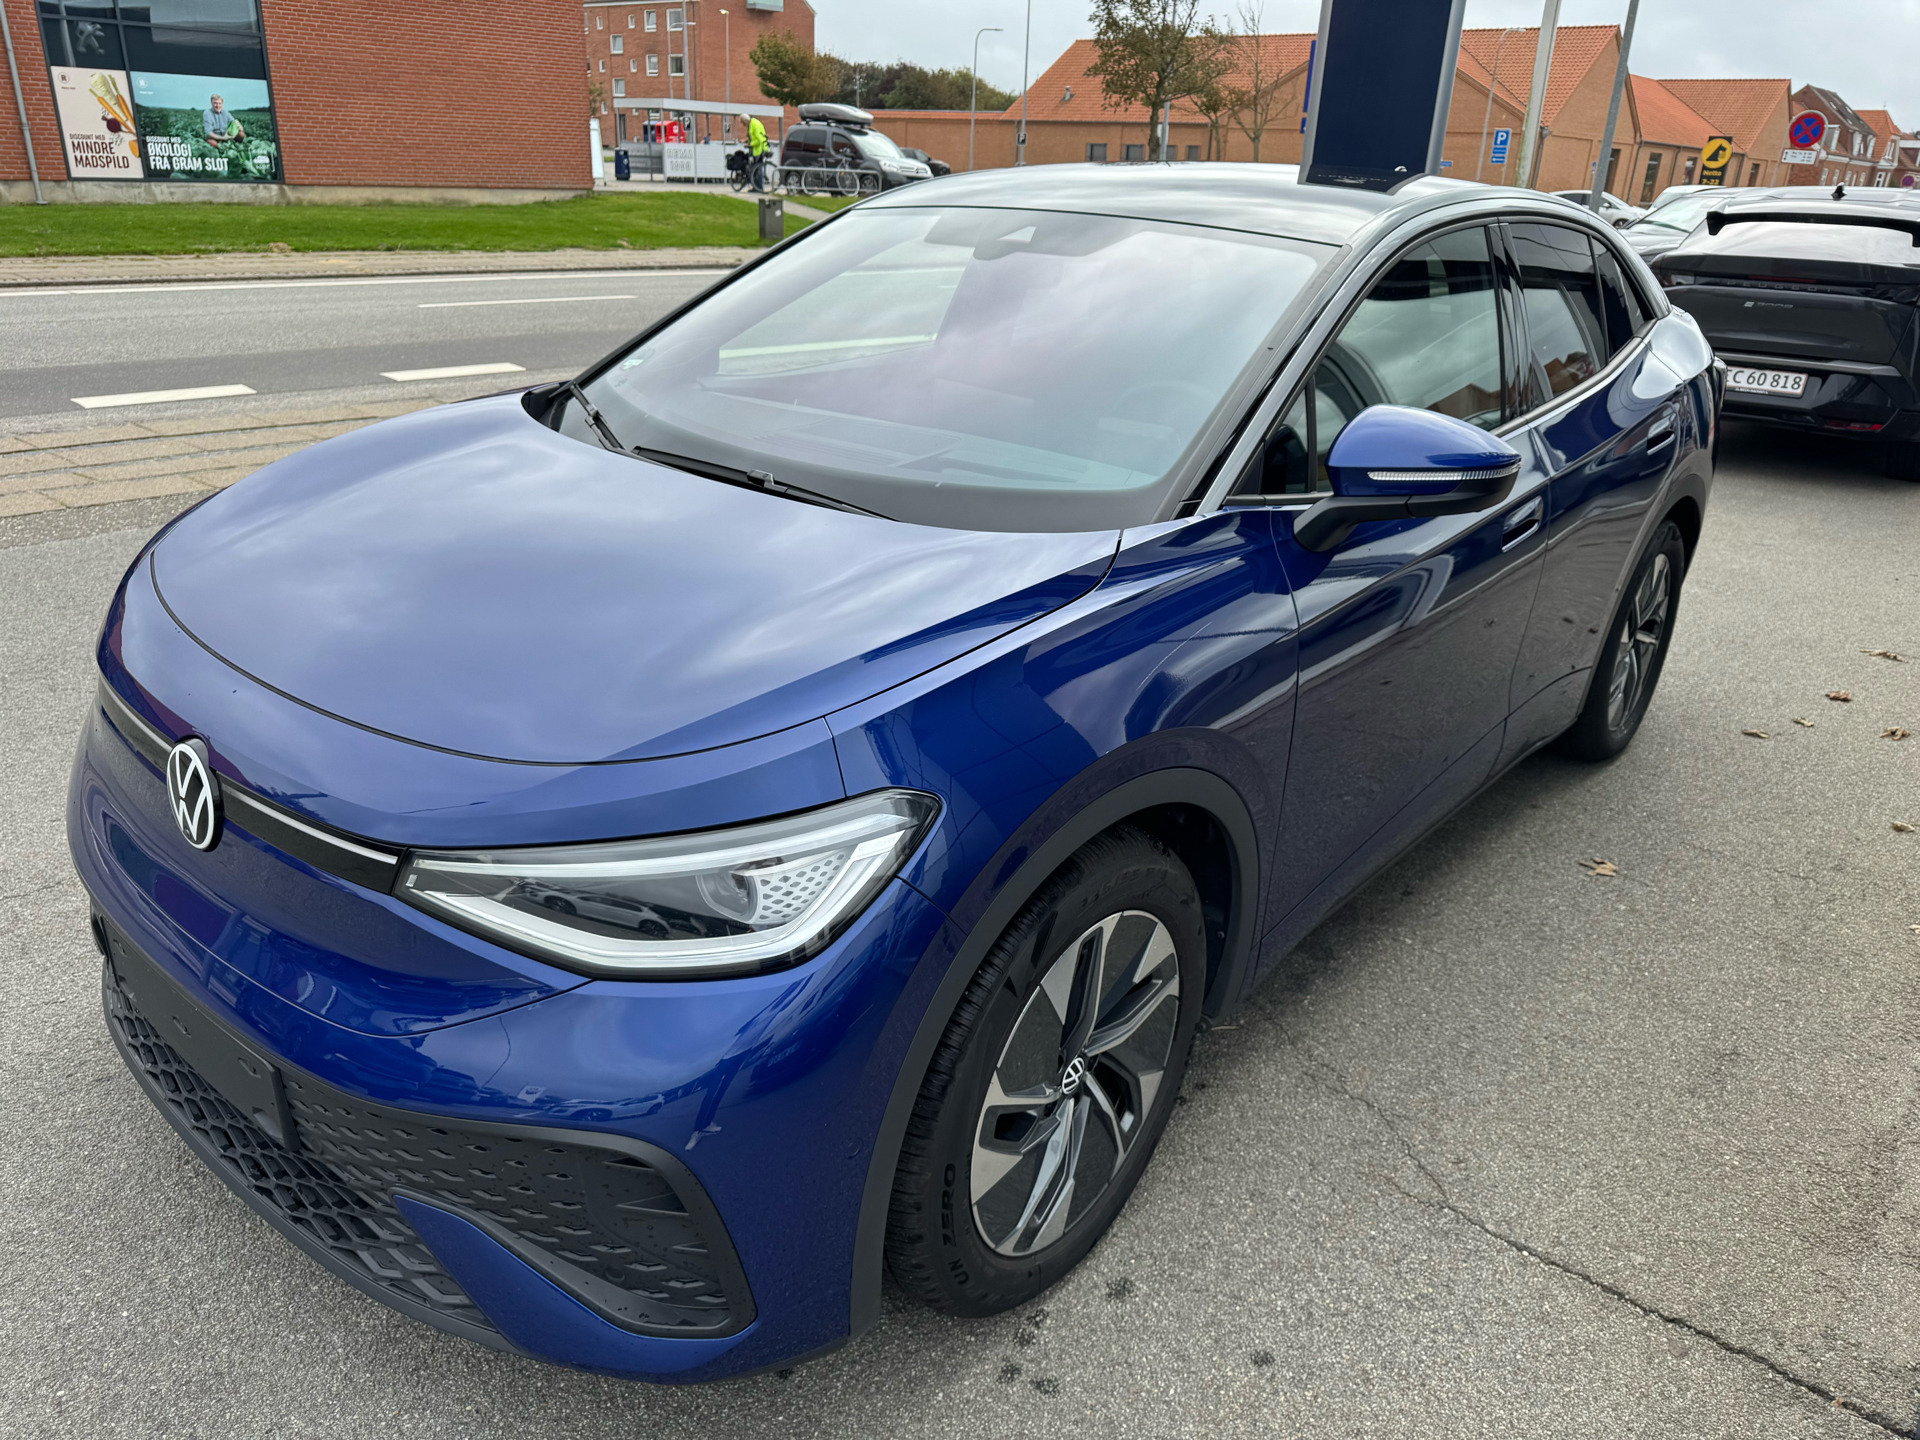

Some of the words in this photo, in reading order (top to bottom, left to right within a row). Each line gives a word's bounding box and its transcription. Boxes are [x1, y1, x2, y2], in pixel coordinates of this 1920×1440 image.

[1496, 132, 1507, 145] P
[71, 141, 115, 155] MINDRE
[147, 143, 192, 157] ØKOLOGI
[74, 155, 130, 168] MADSPILD
[150, 156, 171, 170] FRA
[172, 157, 203, 171] GRAM
[204, 157, 229, 171] SLOT
[1726, 280, 1832, 293] PEUGEOT
[1746, 371, 1768, 386] 60
[1770, 373, 1802, 390] 818
[941, 1163, 957, 1247] ZERO
